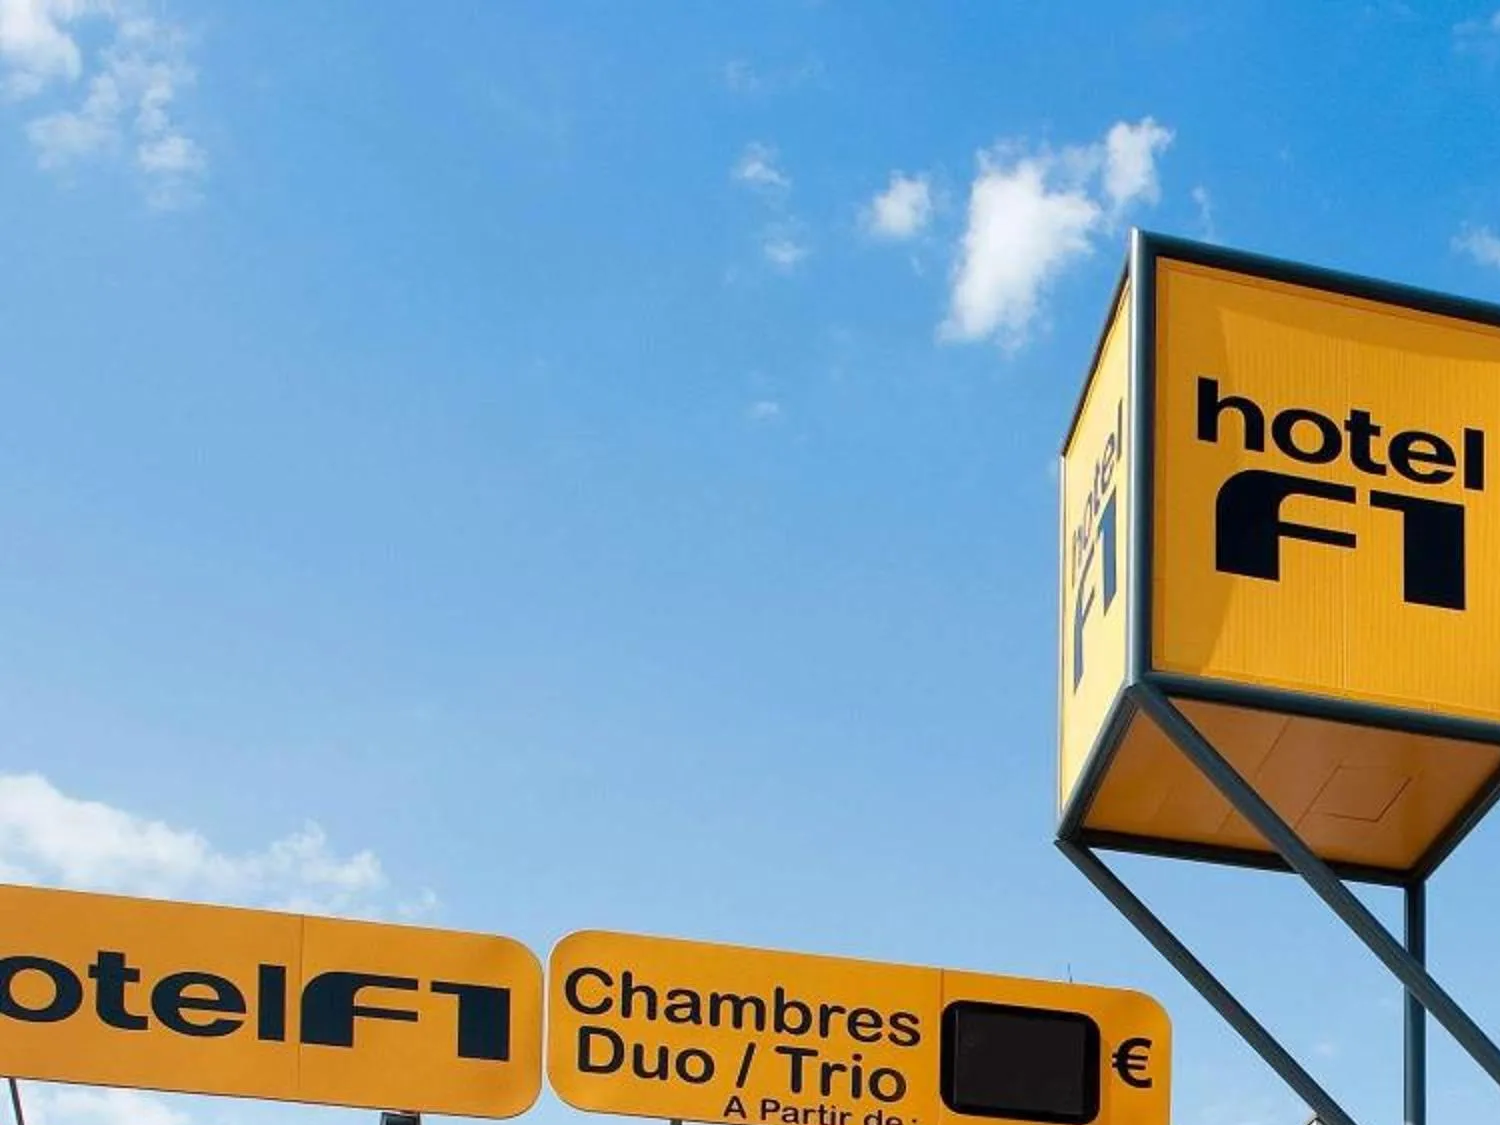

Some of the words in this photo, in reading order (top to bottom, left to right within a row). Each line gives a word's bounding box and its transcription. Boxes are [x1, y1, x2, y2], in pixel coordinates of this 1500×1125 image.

[1195, 375, 1486, 491] hotel
[1072, 396, 1123, 589] hotel
[1215, 469, 1467, 611] F1
[1073, 484, 1118, 696] F1
[0, 949, 512, 1062] otelF1
[563, 966, 922, 1048] Chambres
[576, 1025, 716, 1084] Duo
[735, 1041, 757, 1089] /
[774, 1045, 908, 1103] Trio
[722, 1095, 748, 1119] A
[1111, 1036, 1154, 1090] €
